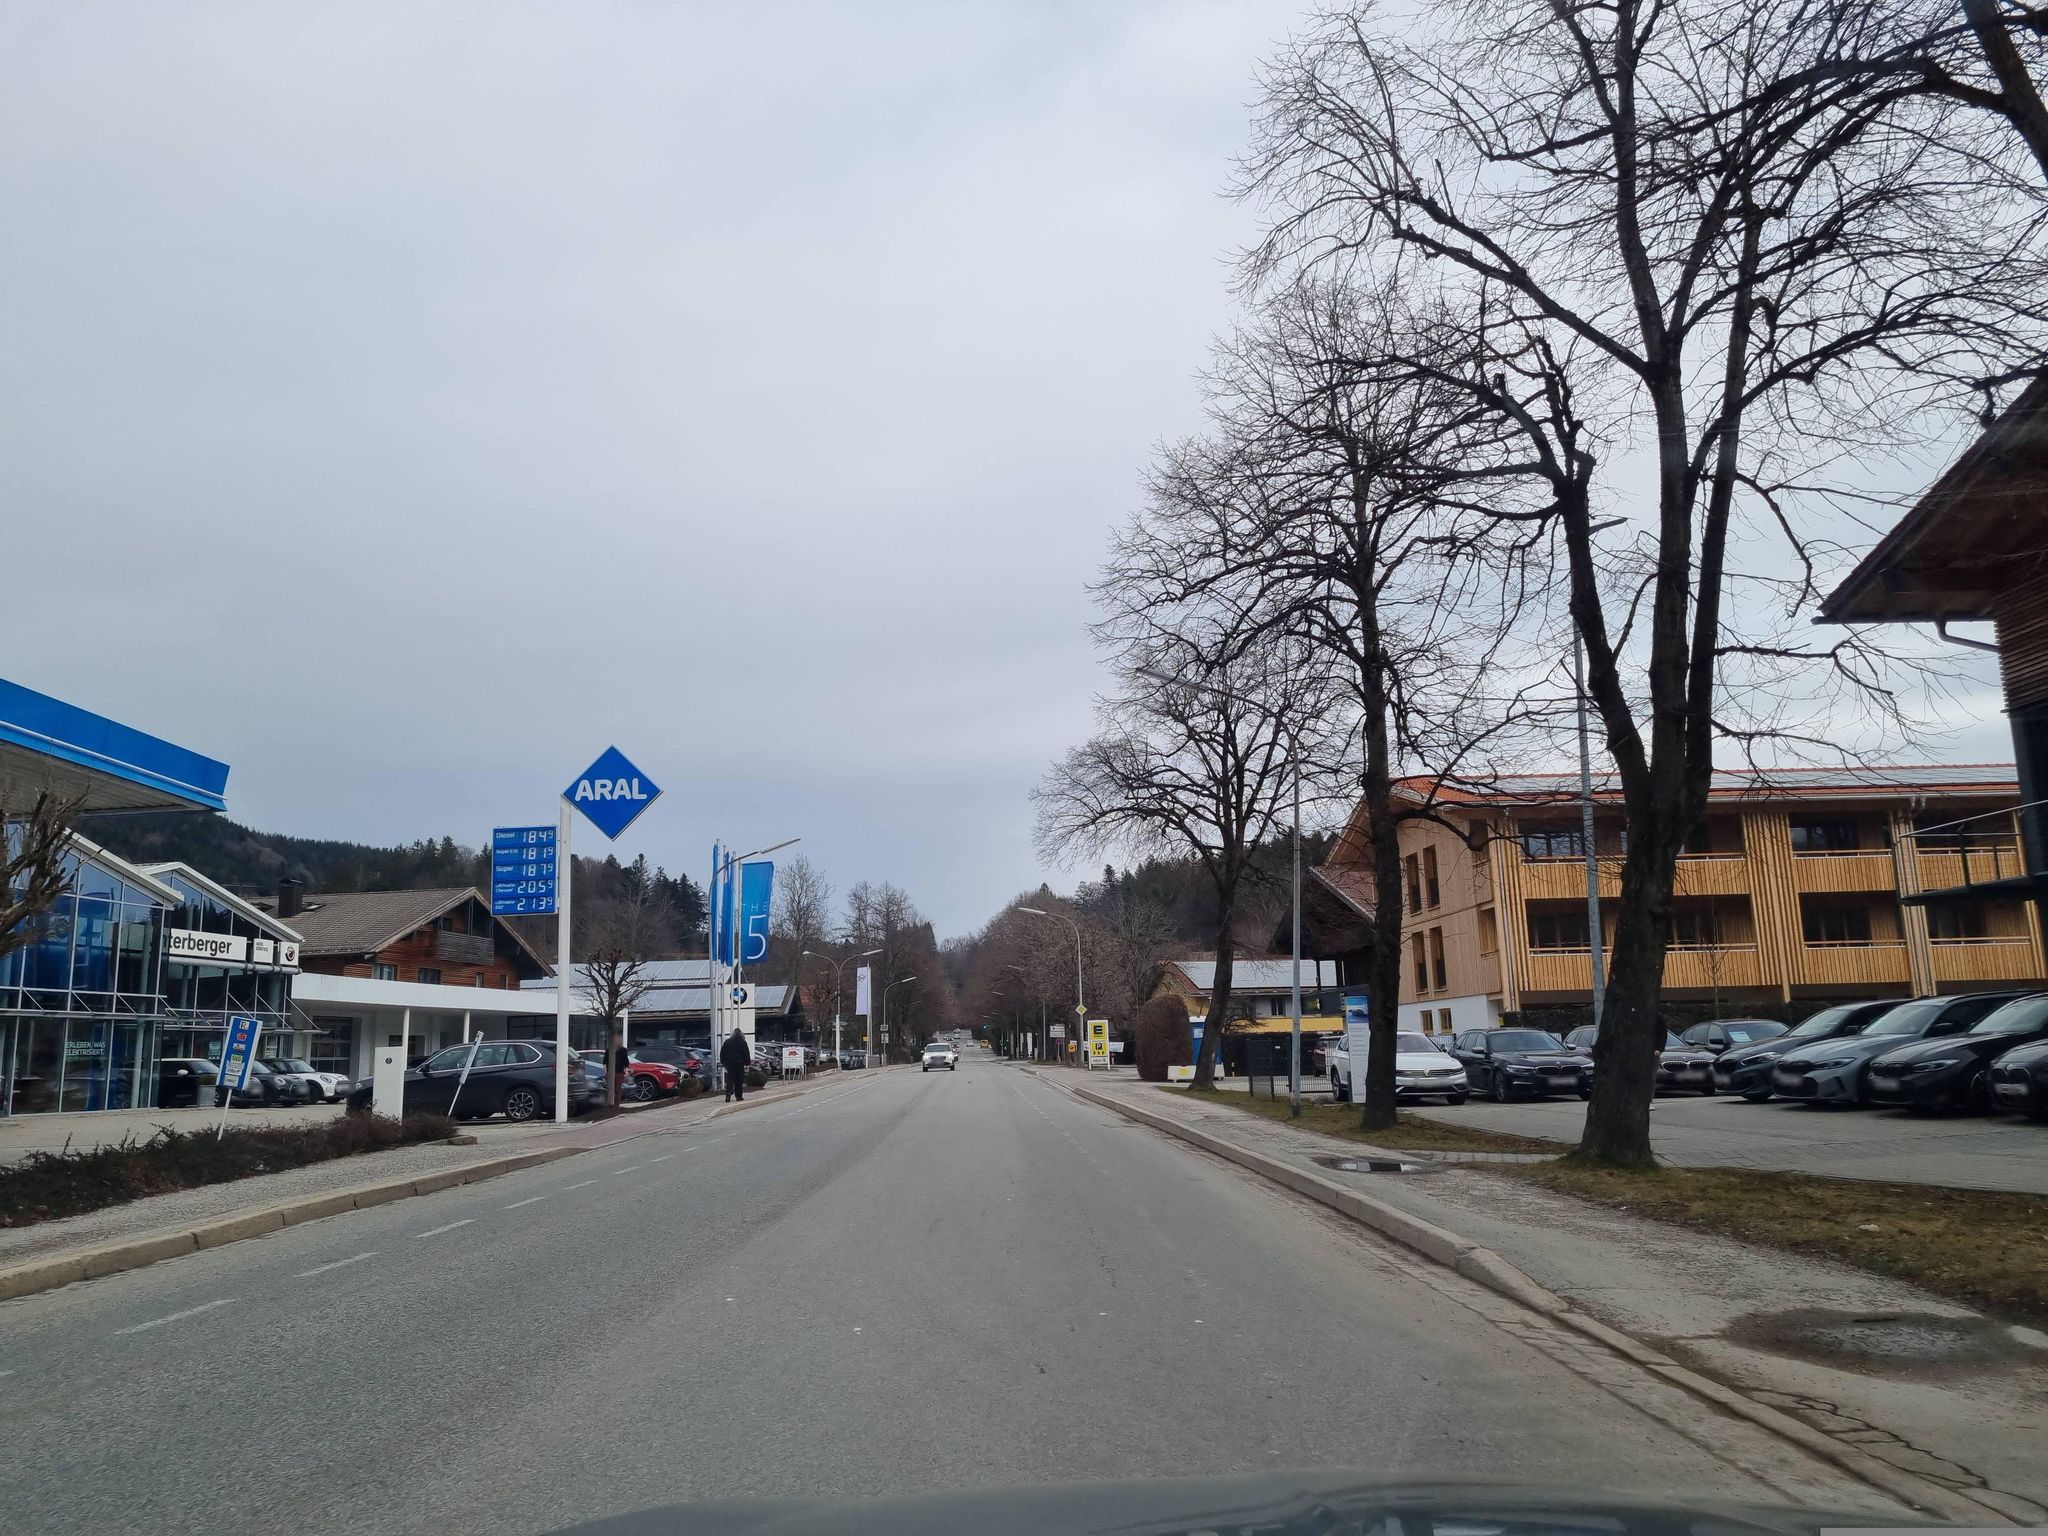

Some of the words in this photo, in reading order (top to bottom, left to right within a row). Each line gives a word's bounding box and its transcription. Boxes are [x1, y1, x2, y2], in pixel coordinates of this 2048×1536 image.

[575, 778, 648, 801] ARAL
[747, 915, 766, 959] 5
[1094, 1026, 1102, 1034] E
[94, 1041, 106, 1049] WAS
